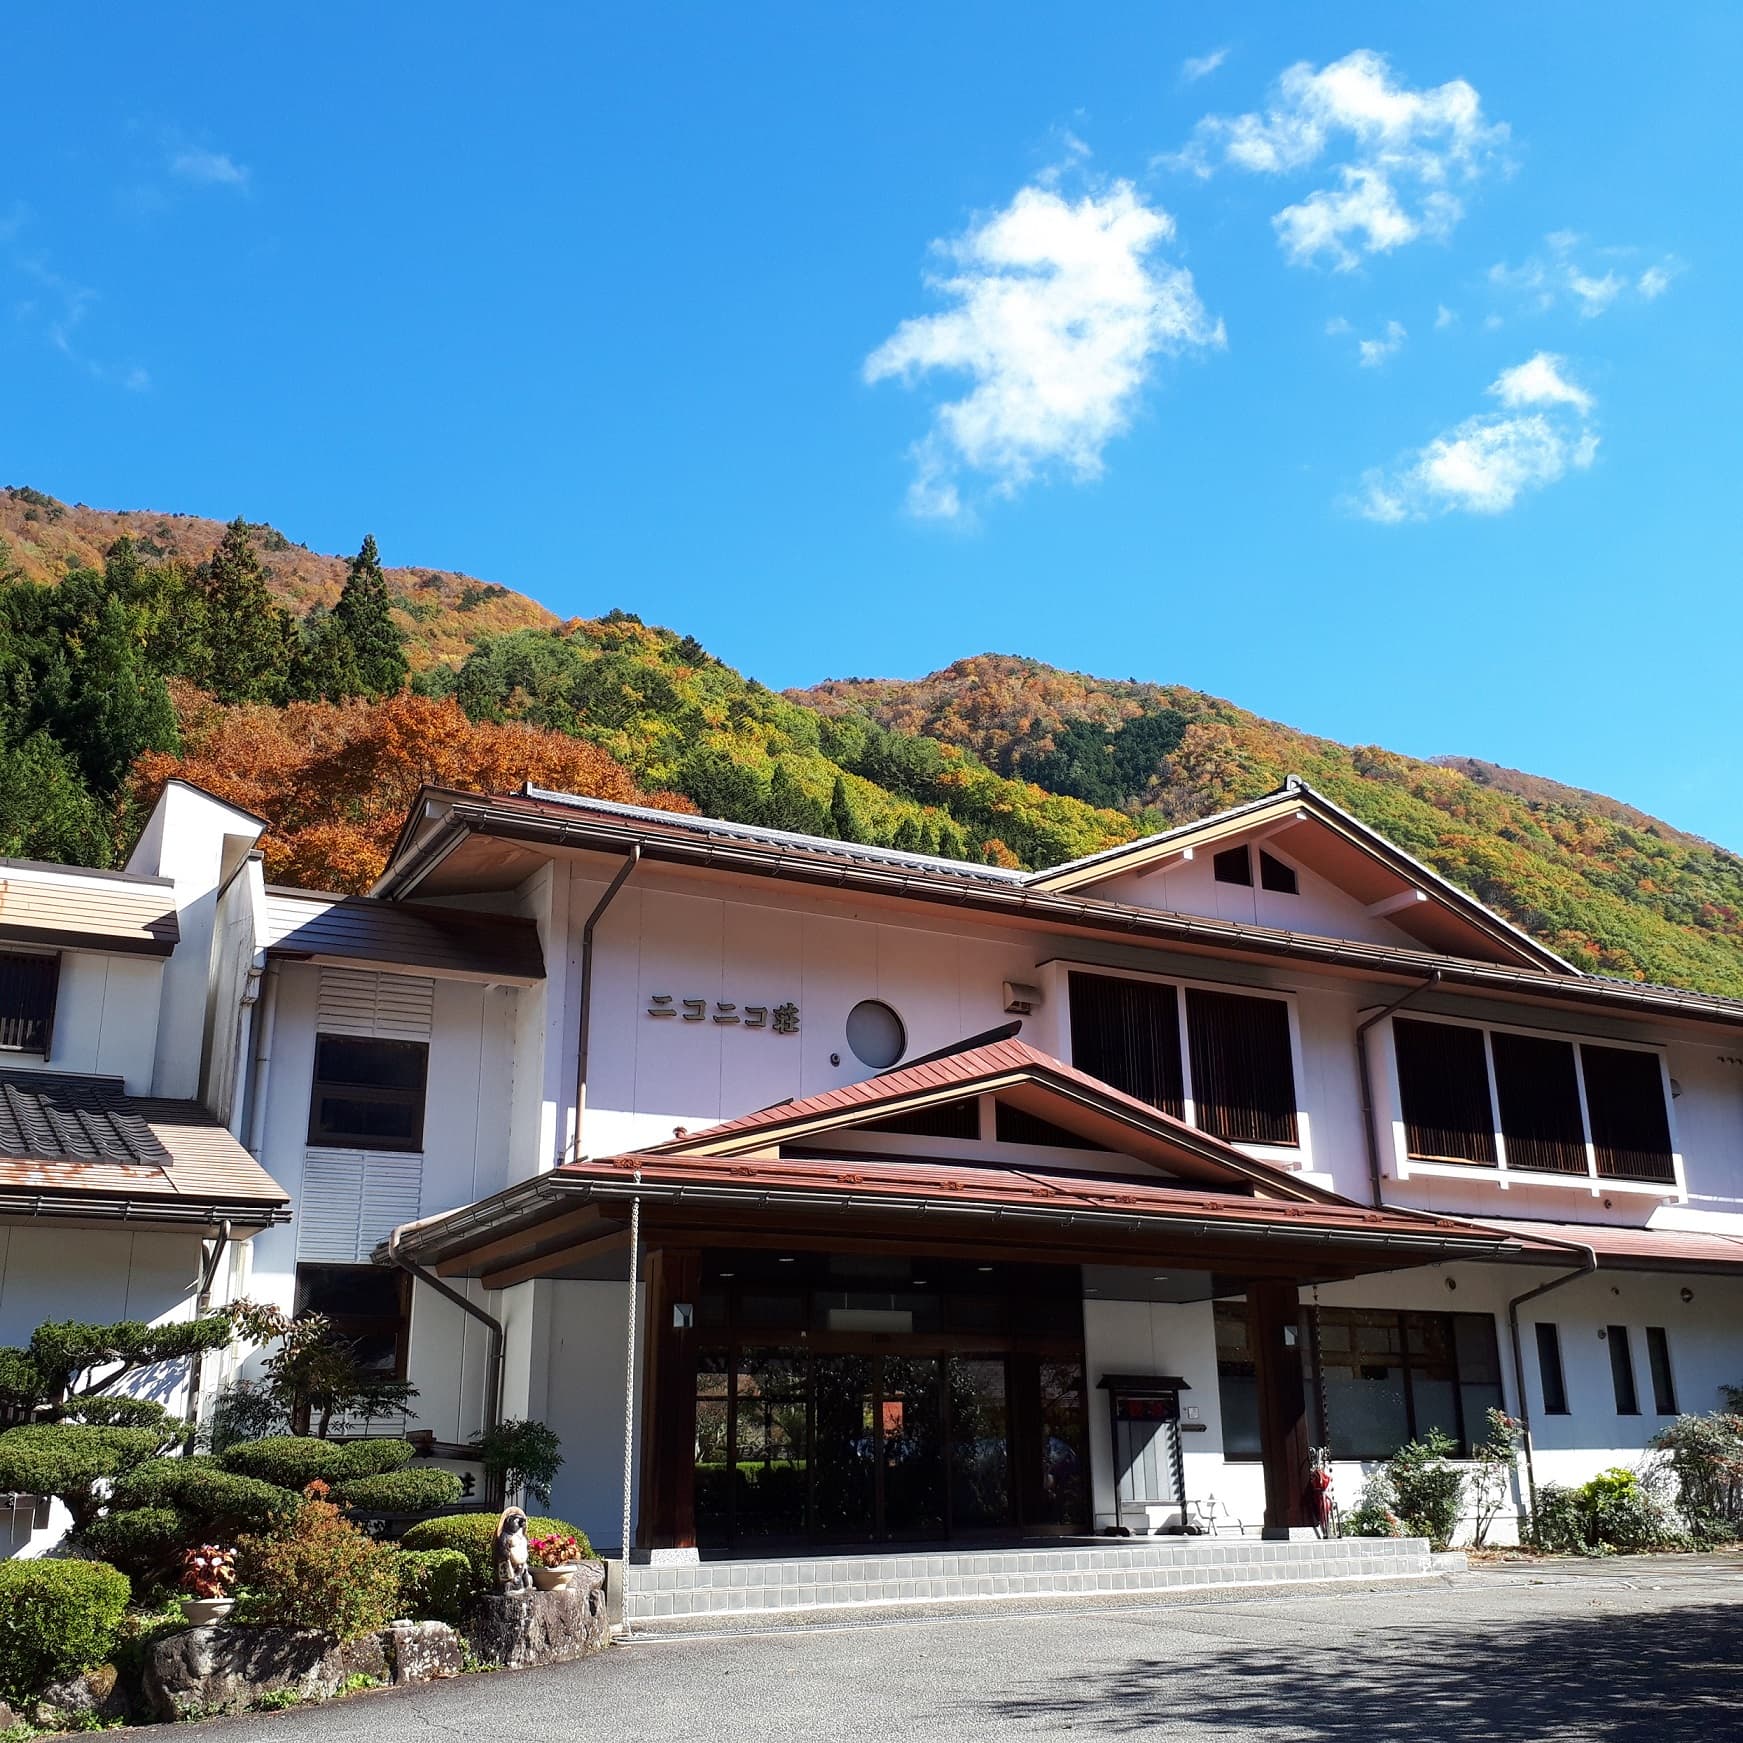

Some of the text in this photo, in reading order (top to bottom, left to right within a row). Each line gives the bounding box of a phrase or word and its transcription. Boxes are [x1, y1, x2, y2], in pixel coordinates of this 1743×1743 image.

[648, 995, 801, 1034] ニコニコ荘
